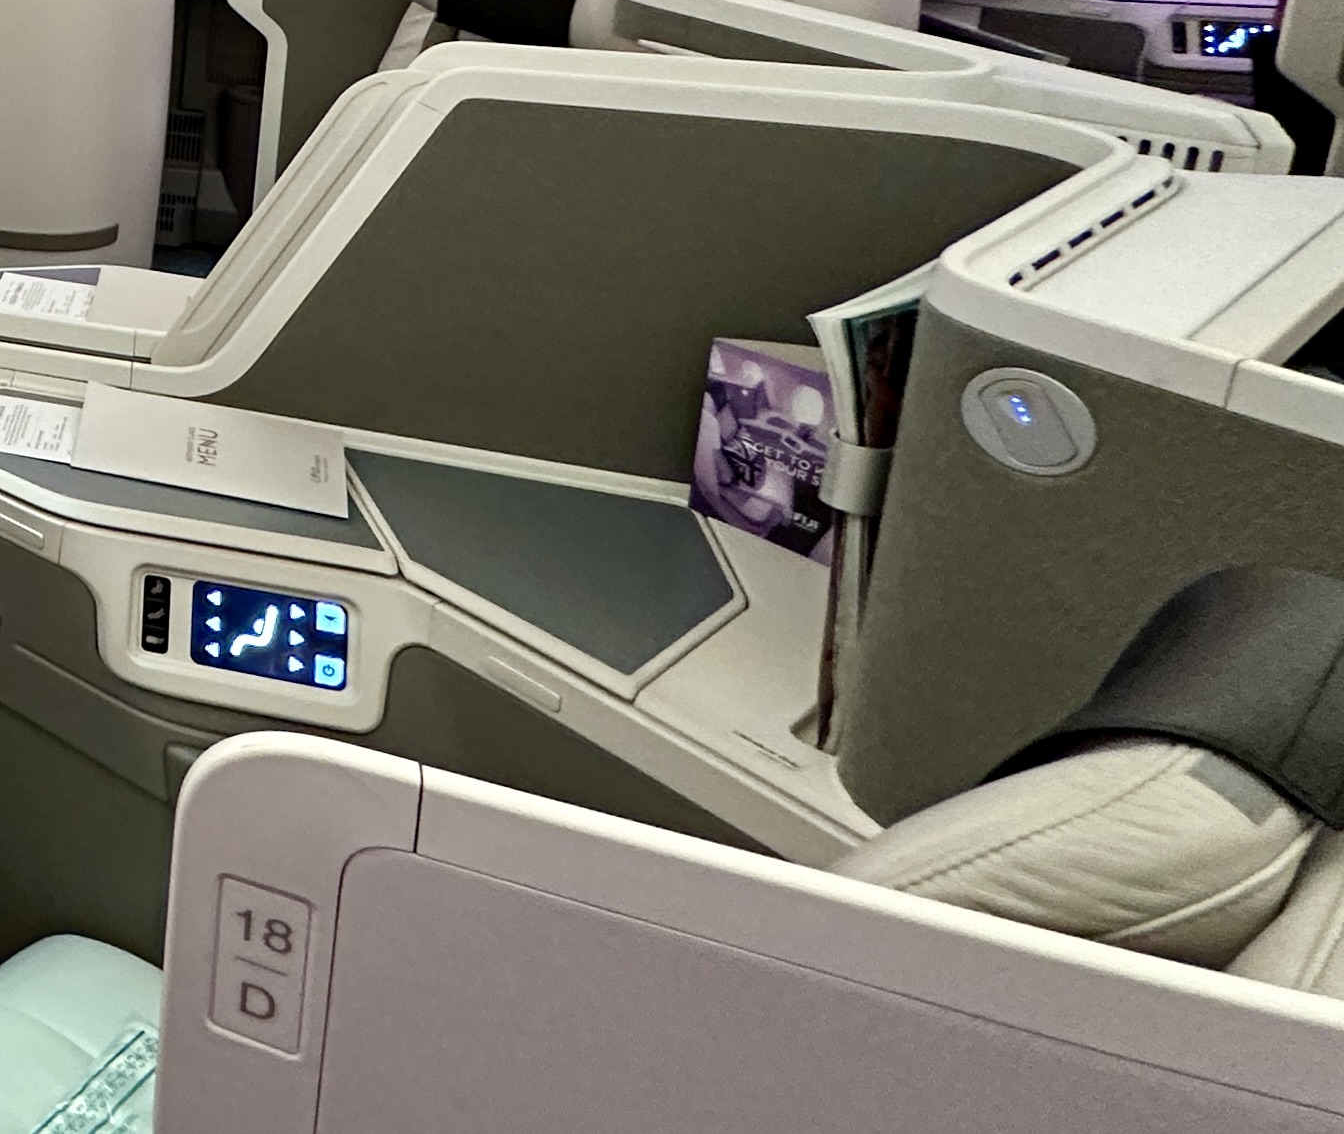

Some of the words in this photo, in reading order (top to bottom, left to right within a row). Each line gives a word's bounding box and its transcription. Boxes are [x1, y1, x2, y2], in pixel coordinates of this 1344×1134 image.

[197, 427, 218, 467] MENU
[788, 454, 812, 471] TO
[764, 456, 808, 481] YOUR
[235, 909, 293, 954] 18
[239, 981, 276, 1020] D
